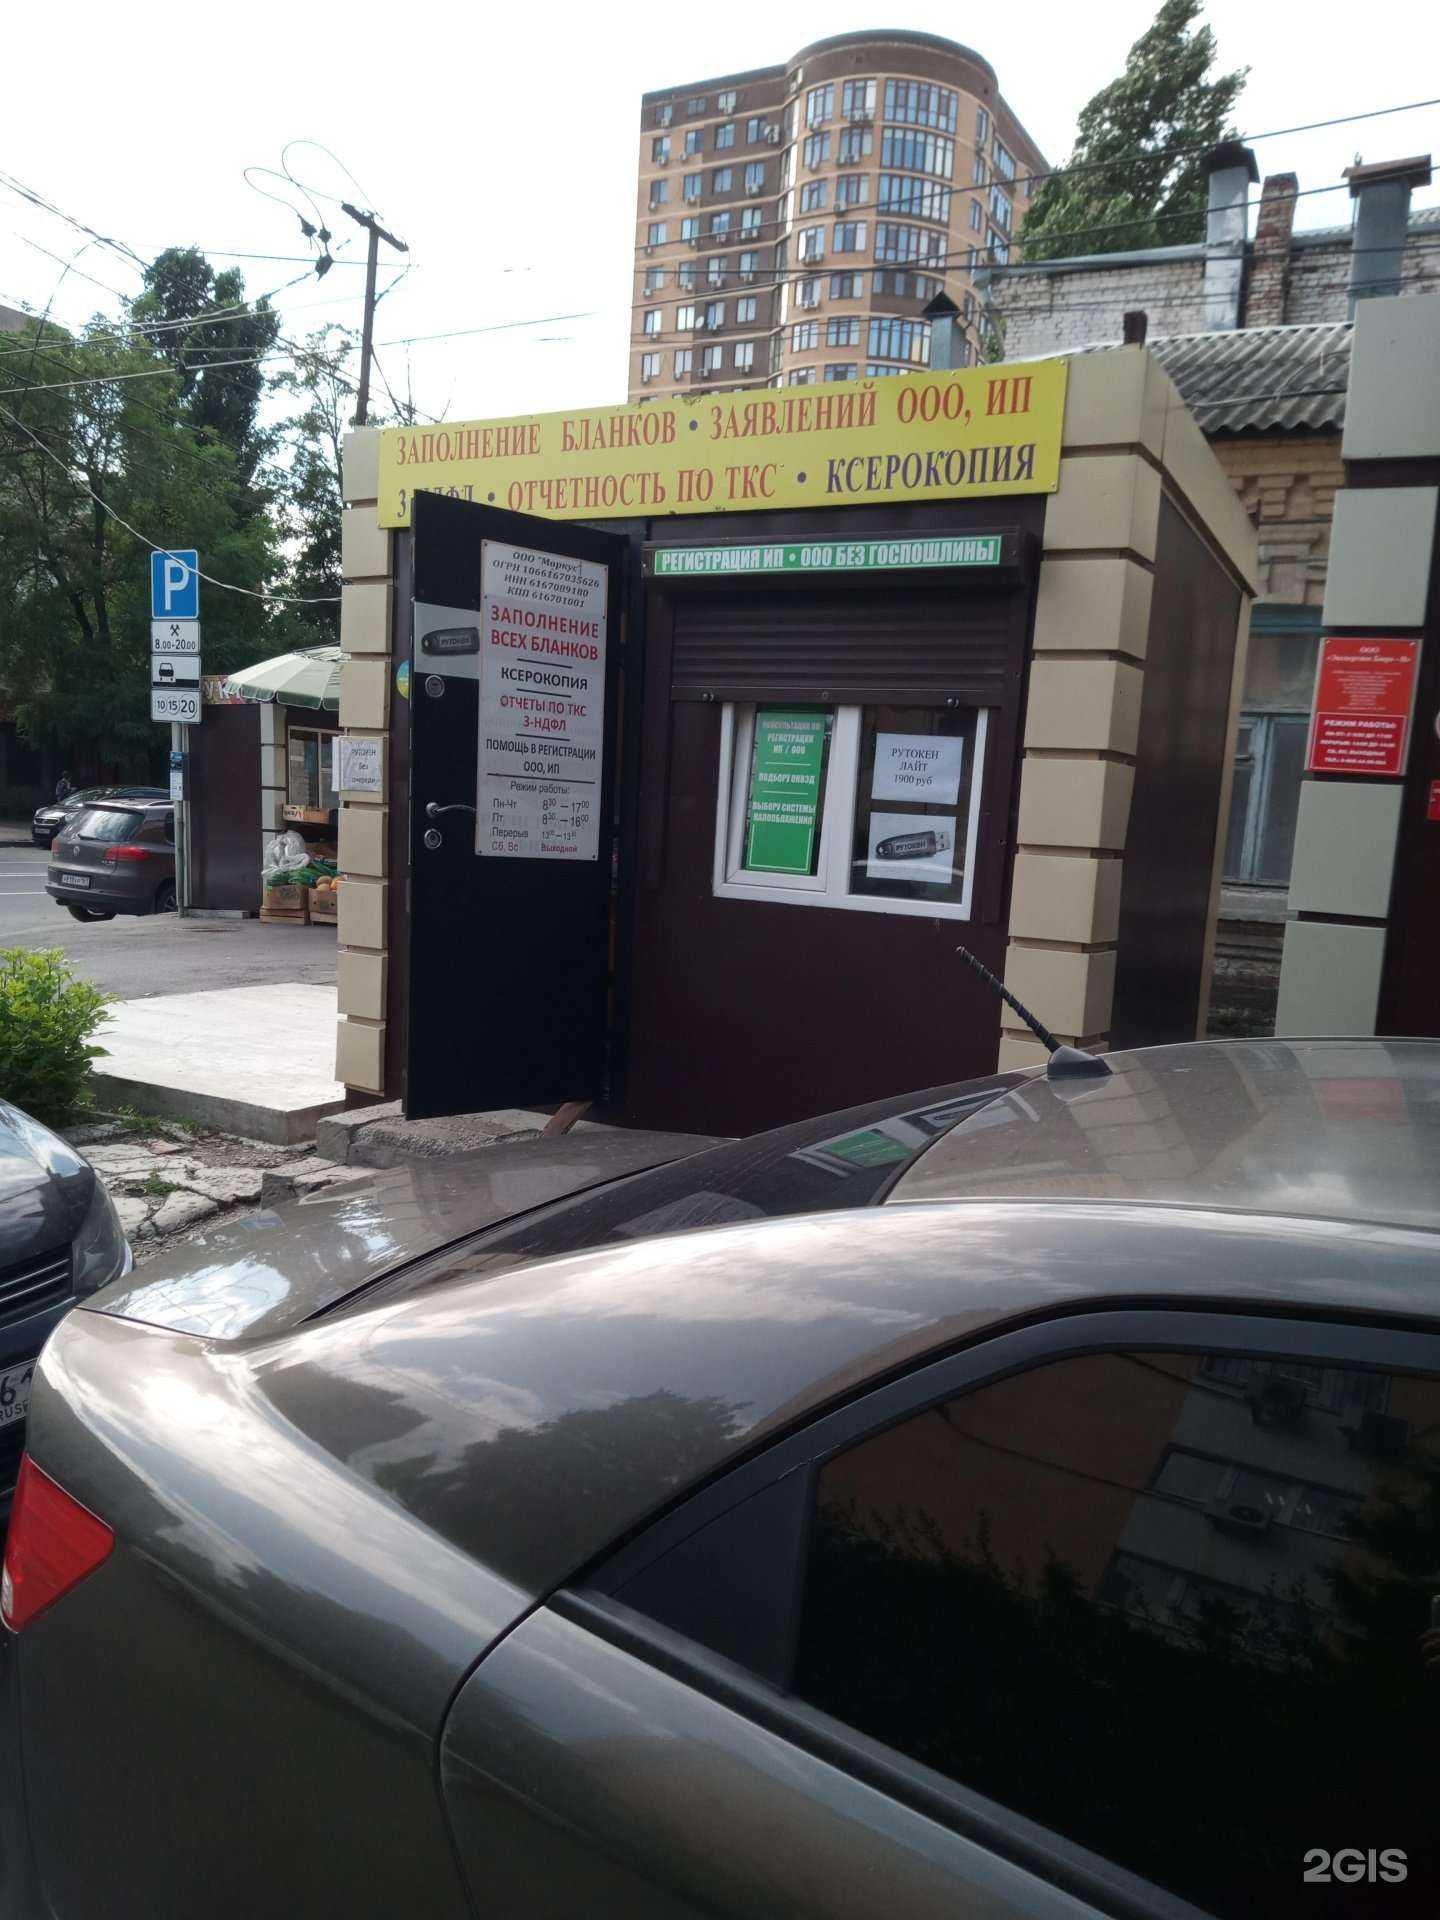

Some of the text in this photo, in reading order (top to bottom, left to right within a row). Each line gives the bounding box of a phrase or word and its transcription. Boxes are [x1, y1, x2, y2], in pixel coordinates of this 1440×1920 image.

[397, 376, 1034, 466] ЗАПОЛНЕНИЕ БЛАНКОВ ЗАЯВЛЕНИЙ ООО, ИП
[508, 471, 666, 512] ОТЧЕТНОСТЬ
[677, 468, 714, 503] ПО
[725, 464, 777, 499] ТКС
[826, 443, 1037, 494] КСЕРОКОПИЯ
[512, 551, 535, 563] ООО
[662, 540, 995, 572] РЕГИСТРАЦИЯ ИП ООО БЕЗ ГОСПОШЛИНЫ
[492, 559, 521, 572] ОГРН
[504, 574, 527, 586] ИНН
[507, 586, 529, 598] КПП
[491, 604, 599, 639] ЗАПОЛНЕНИЕ
[491, 629, 599, 661] ВСЕХ БЛАНКОВ
[501, 667, 588, 690] КСЕРОКОПИЯ
[157, 699, 195, 713] 10 15 20
[500, 695, 587, 717] ОТЧЕТЫ ПО ТКС
[523, 715, 566, 732] 3-НДФЛ
[486, 738, 596, 760] ПОМОЩЬ В РЕГИСТРАЦИИ
[891, 747, 941, 760] РУТОКЕН
[547, 762, 560, 774] ИП
[898, 759, 929, 773] ЛАЙТ
[510, 782, 537, 792] Режим
[894, 775, 933, 788] 1900 руб
